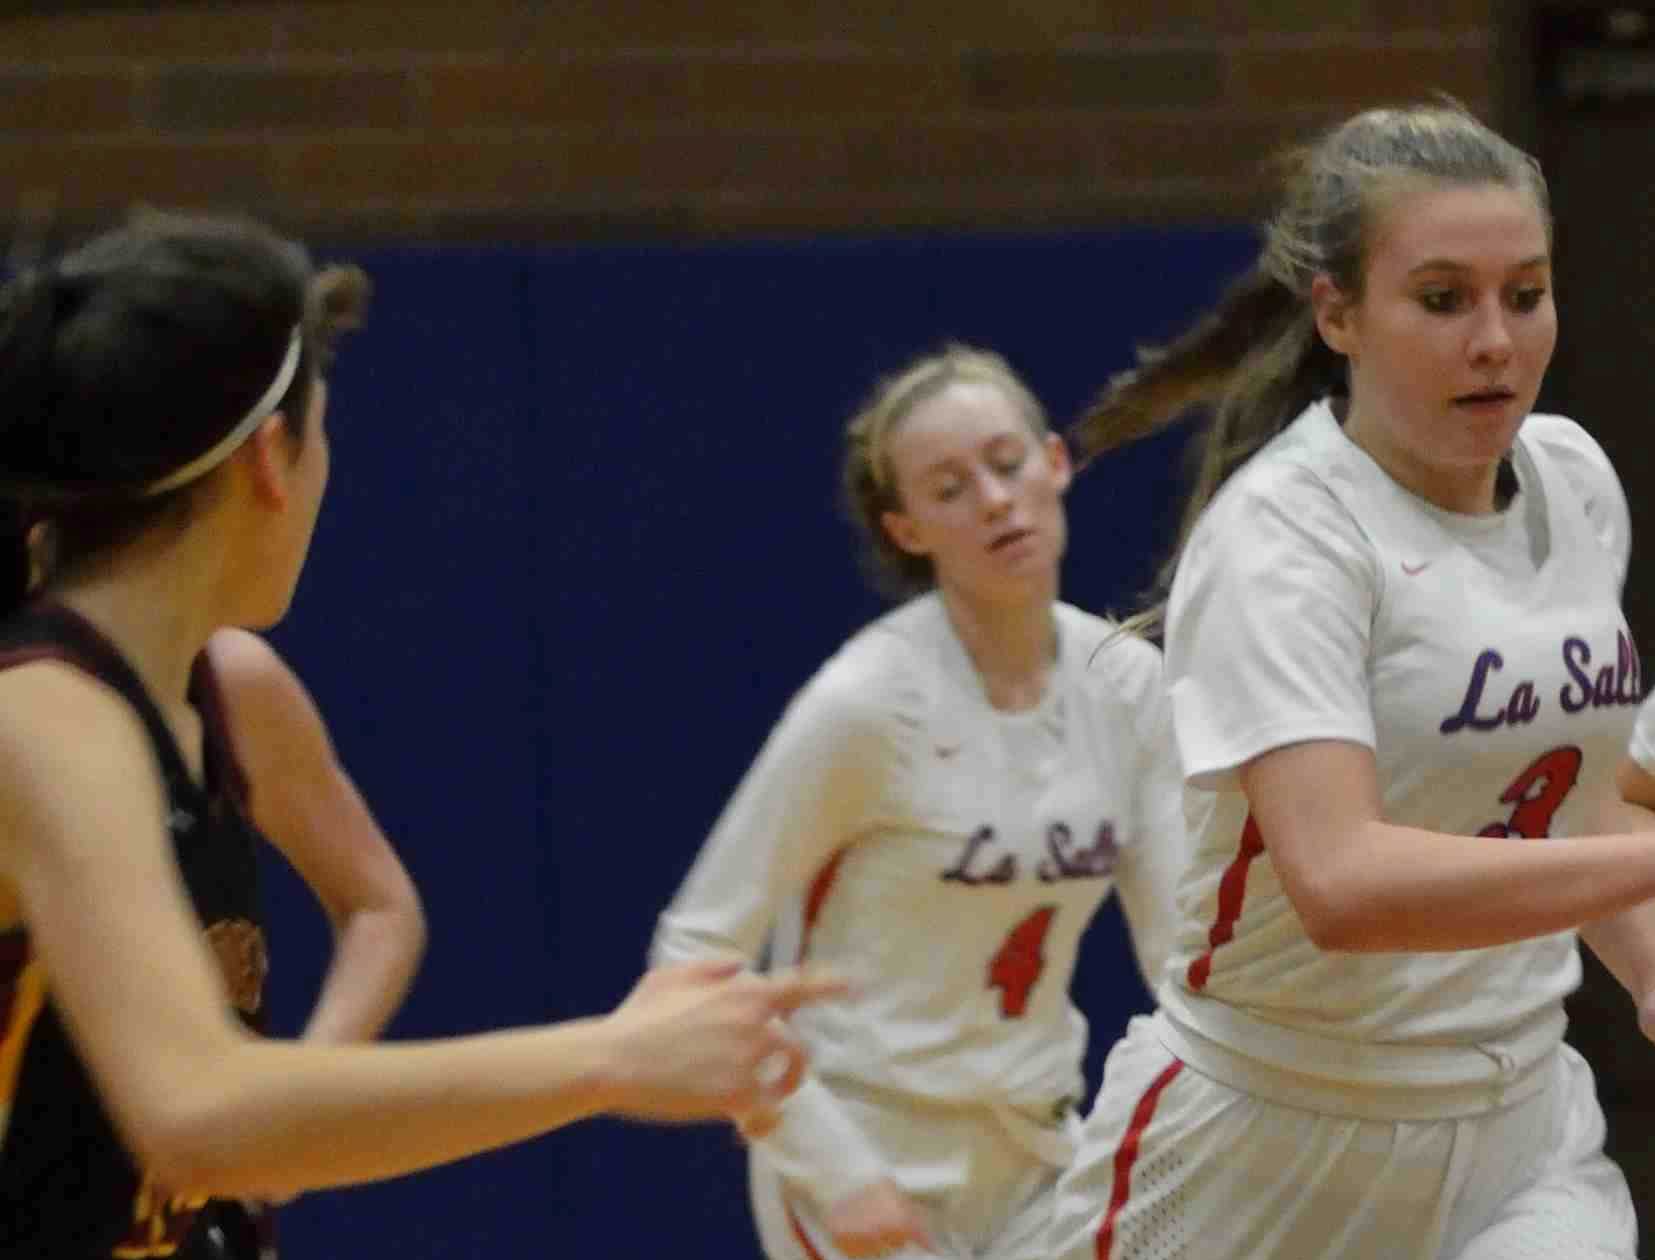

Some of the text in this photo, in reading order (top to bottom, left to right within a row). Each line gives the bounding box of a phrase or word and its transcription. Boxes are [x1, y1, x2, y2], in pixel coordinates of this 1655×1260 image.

[1439, 647, 1540, 735] La
[939, 823, 1016, 886] La
[984, 901, 1062, 1020] 4
